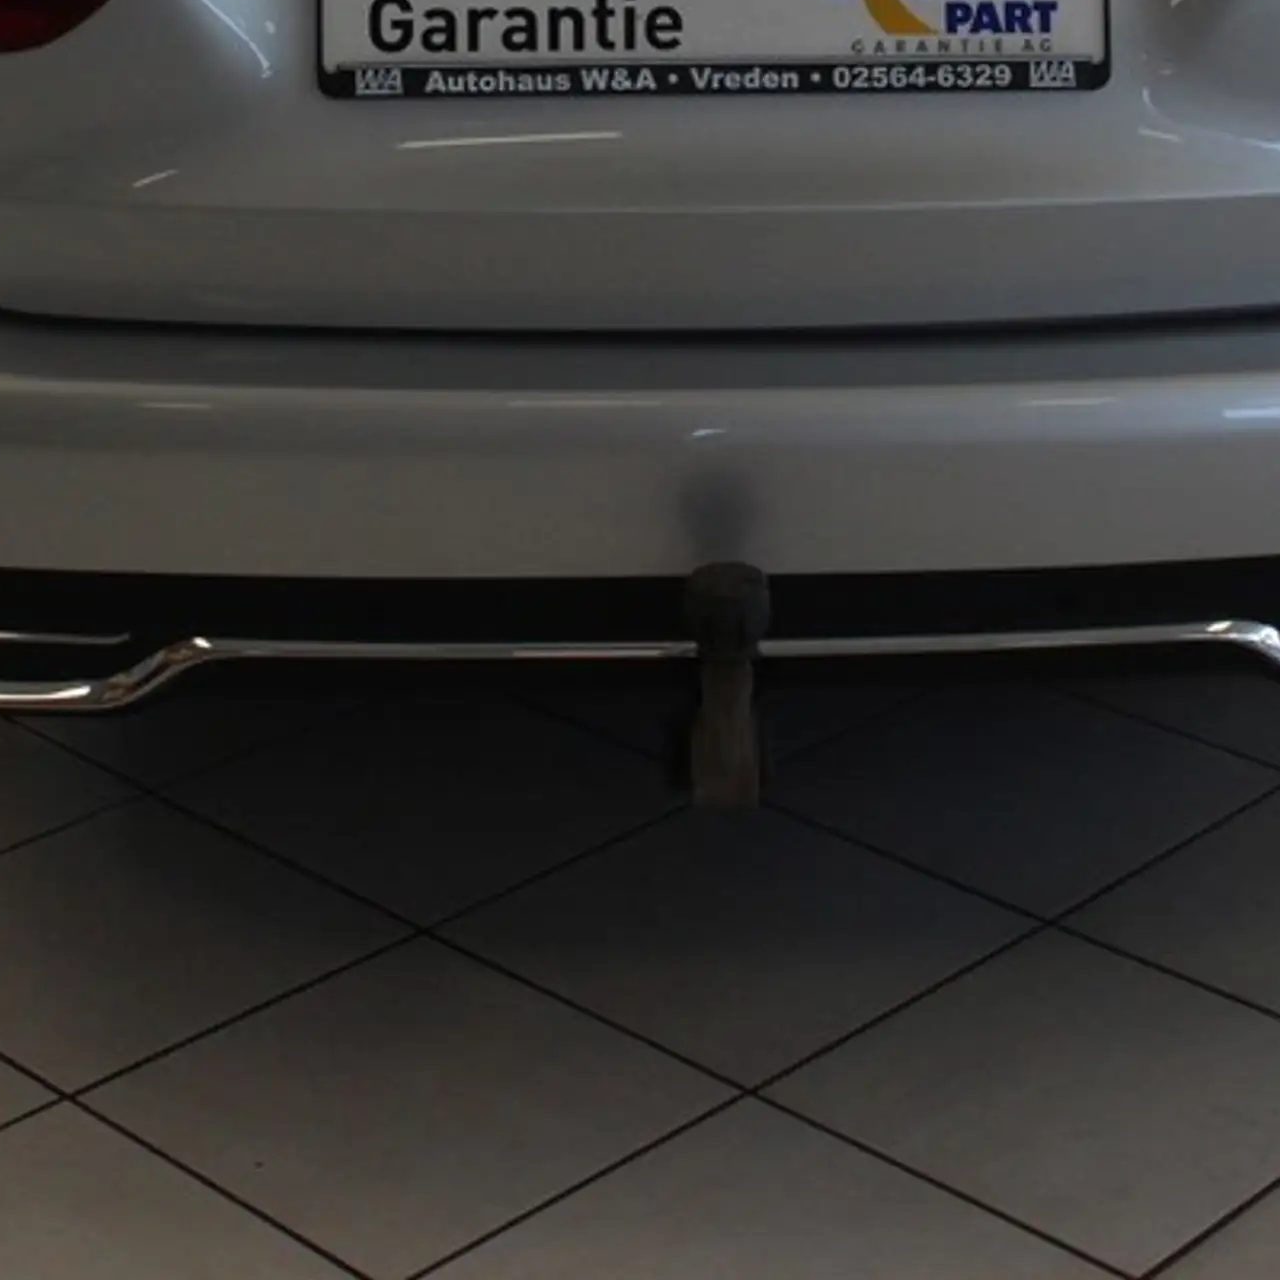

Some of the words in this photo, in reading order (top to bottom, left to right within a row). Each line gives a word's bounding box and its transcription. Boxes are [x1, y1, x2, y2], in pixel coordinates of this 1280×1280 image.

[945, 0, 1058, 34] PART
[850, 38, 1003, 54] GARANTIE
[1021, 38, 1053, 53] AG
[424, 69, 571, 93] Autohaus
[580, 66, 657, 91] W&A
[689, 66, 800, 90] Vreden
[833, 63, 1013, 89] 02564-6329
